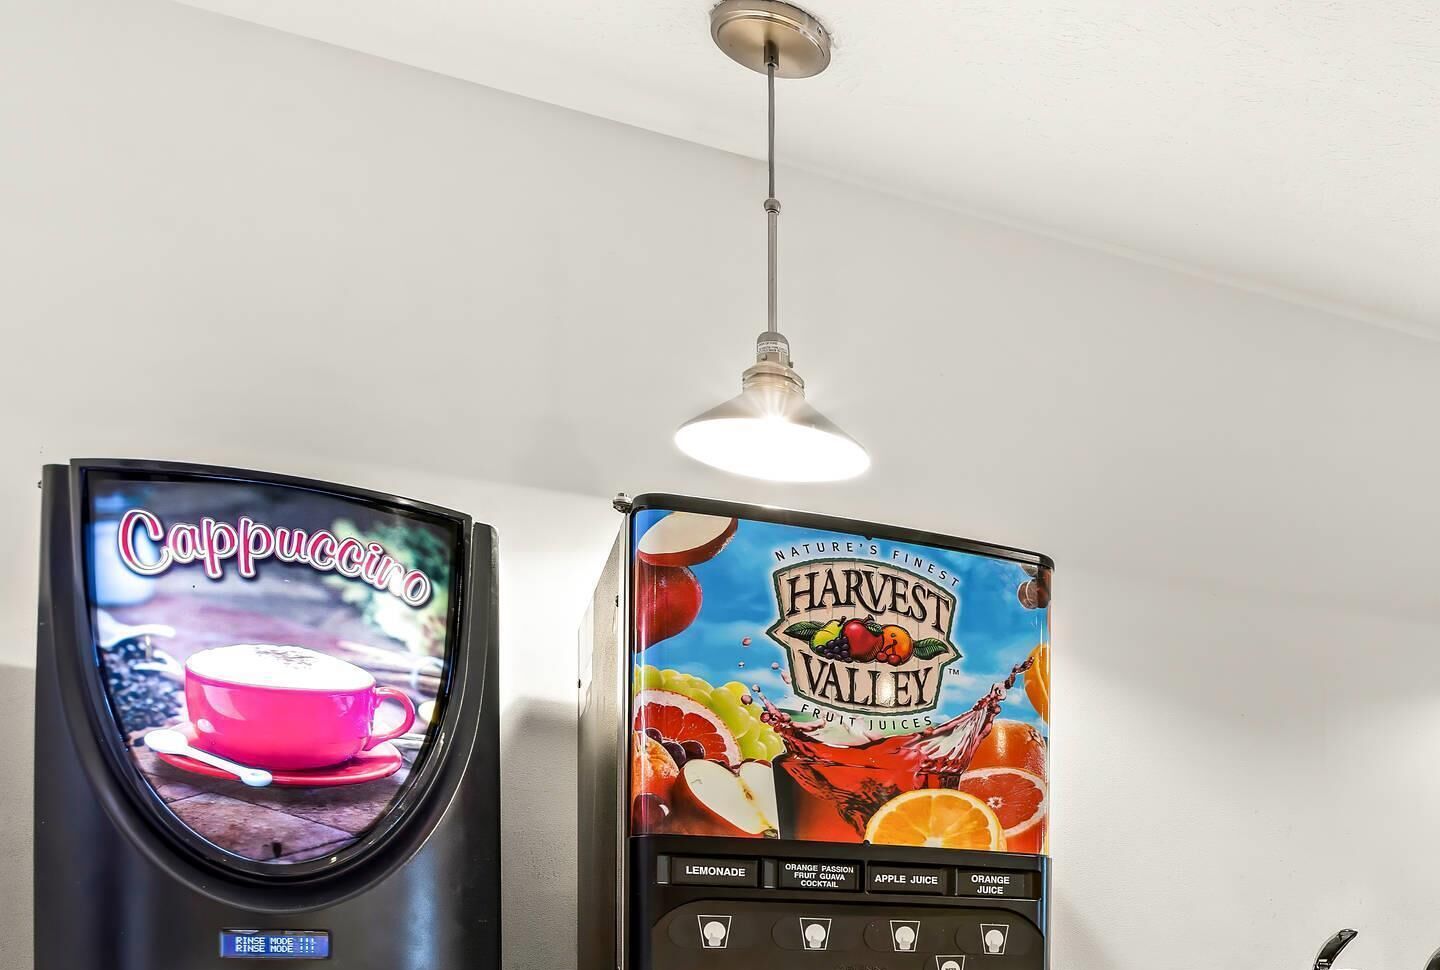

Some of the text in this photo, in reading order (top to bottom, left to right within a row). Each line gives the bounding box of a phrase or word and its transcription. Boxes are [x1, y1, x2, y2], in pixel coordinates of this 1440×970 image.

[118, 509, 432, 607] Cappuccino
[775, 541, 960, 587] NATURE'S FINEST
[785, 568, 951, 634] HARVEST
[798, 650, 932, 708] VALLEY
[800, 703, 932, 731] FRUIT JUICES
[686, 865, 746, 877] LEMONADE
[785, 863, 854, 874] ORANGE PASSION
[793, 872, 845, 881] FRUIT GUAVA
[874, 874, 938, 885] APPLE JUICE
[971, 874, 1010, 884] ORANGE
[800, 879, 839, 888] COCKTAIL
[976, 886, 1004, 895] JUICE
[235, 936, 265, 945] RINSE
[270, 937, 294, 945] MODE
[235, 945, 265, 953] RINSE
[270, 945, 294, 953] MODE
